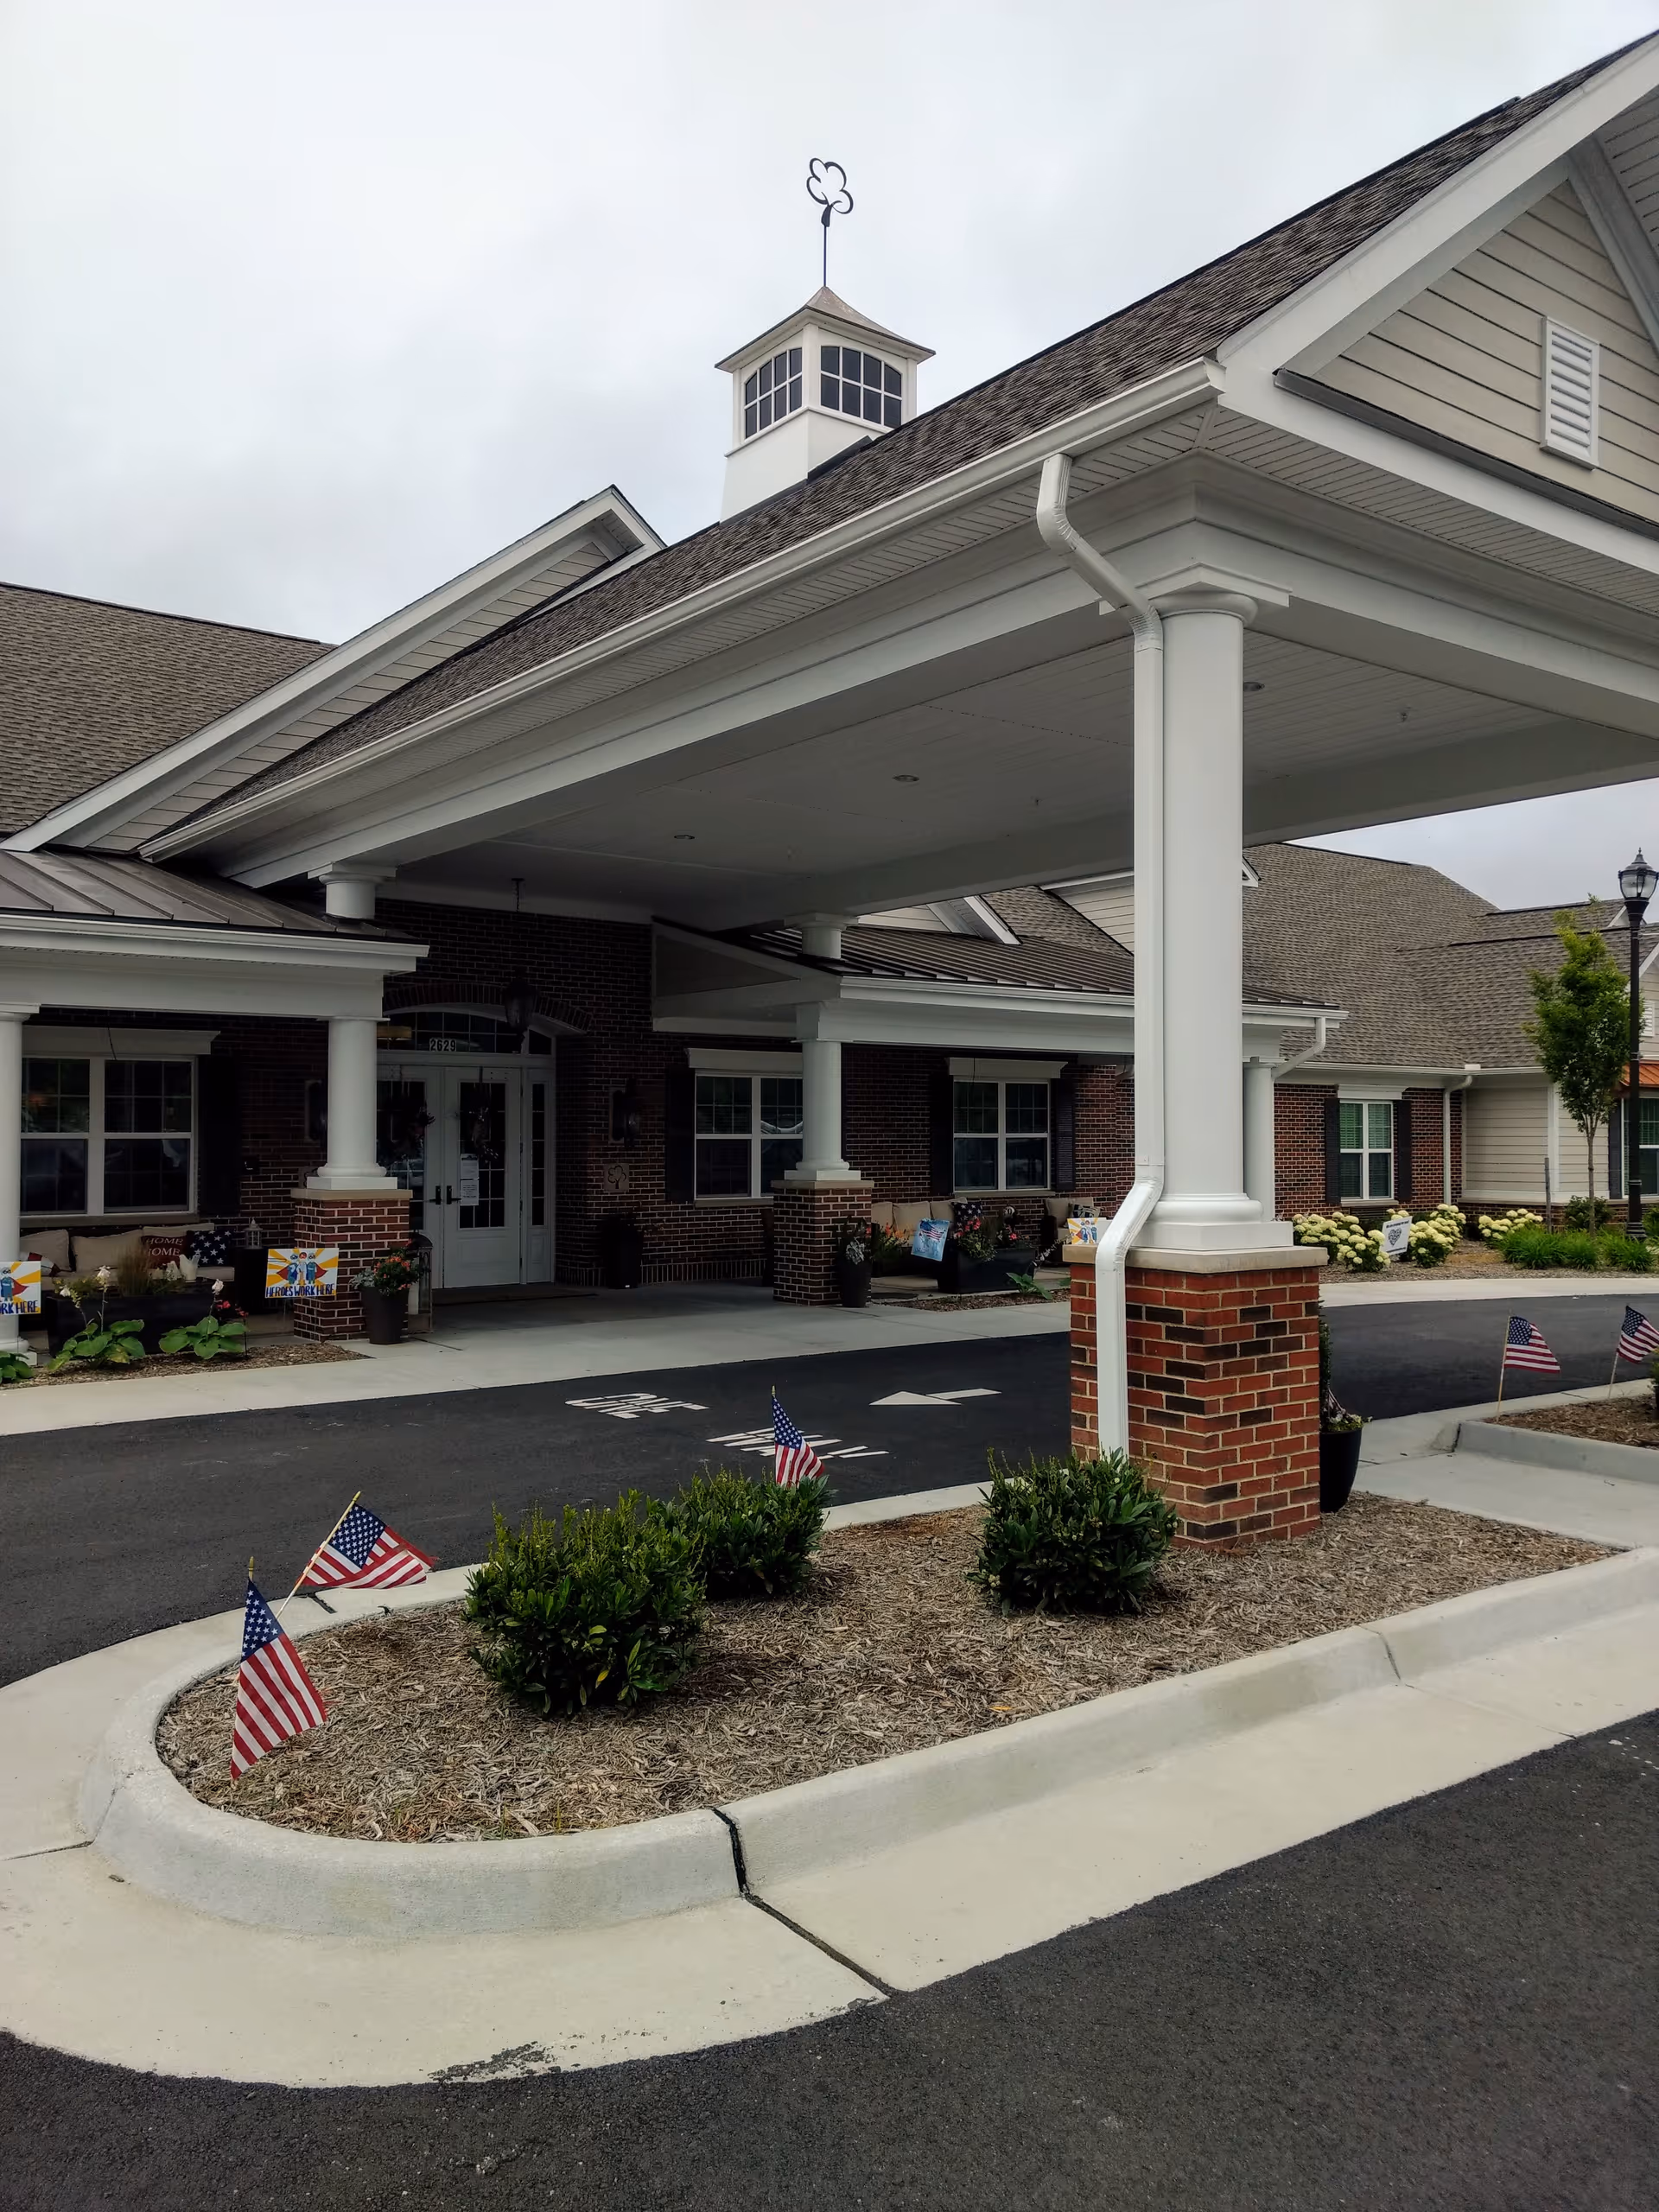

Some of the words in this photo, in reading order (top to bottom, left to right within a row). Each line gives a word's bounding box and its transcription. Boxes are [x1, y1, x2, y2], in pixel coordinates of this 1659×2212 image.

[430, 1039, 456, 1052] 2629
[265, 1286, 293, 1298] HEROES
[294, 1285, 316, 1297] WORK
[316, 1283, 335, 1296] HERE
[16, 1300, 39, 1313] HERE
